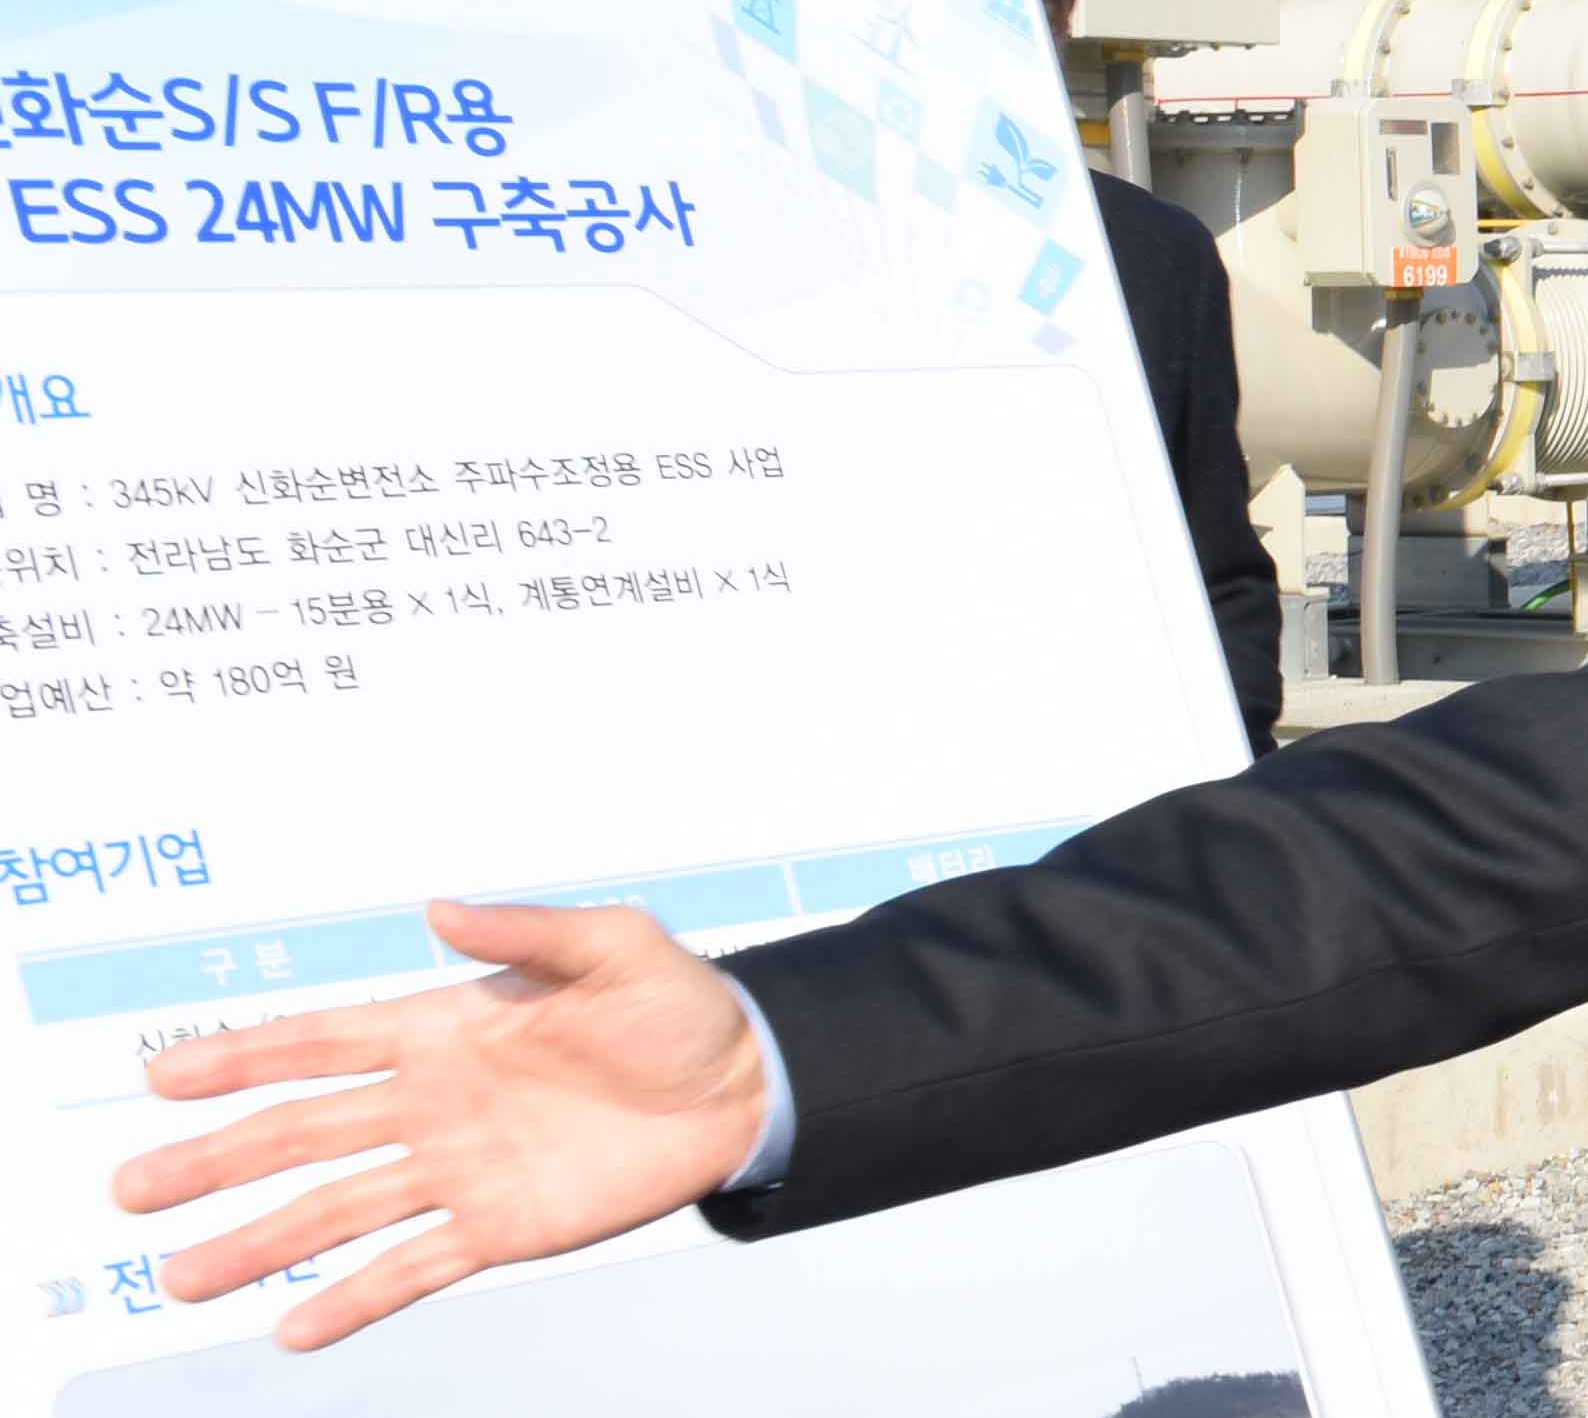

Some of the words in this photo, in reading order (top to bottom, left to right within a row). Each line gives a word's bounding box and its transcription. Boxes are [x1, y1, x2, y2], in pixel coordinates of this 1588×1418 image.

[0, 69, 301, 151] 화순S/S
[312, 77, 513, 157] F/R용
[9, 178, 169, 244] ESS
[185, 178, 405, 243] 24MW
[431, 175, 696, 254] 구축공사
[1403, 264, 1448, 287] 6199
[25, 480, 62, 518] 명
[109, 474, 213, 509] 345kV
[236, 463, 441, 505] 신화순변전소
[454, 451, 642, 492] 주파수조정용
[655, 451, 713, 480] ESS
[728, 445, 785, 479] 사업
[126, 535, 271, 576] 전라남도
[286, 527, 389, 565] 화순군
[404, 518, 504, 559] 대신리
[517, 515, 613, 549] 643-2
[142, 602, 242, 636] 24MW
[289, 587, 394, 627] 15분용
[519, 566, 703, 611] 계통연계설비
[747, 560, 791, 593] 1식
[159, 667, 196, 704] 약
[213, 658, 308, 698] 180억
[323, 654, 360, 691] 원
[0, 828, 211, 907] 참여기업
[201, 947, 239, 987] 구
[254, 937, 293, 981] 분
